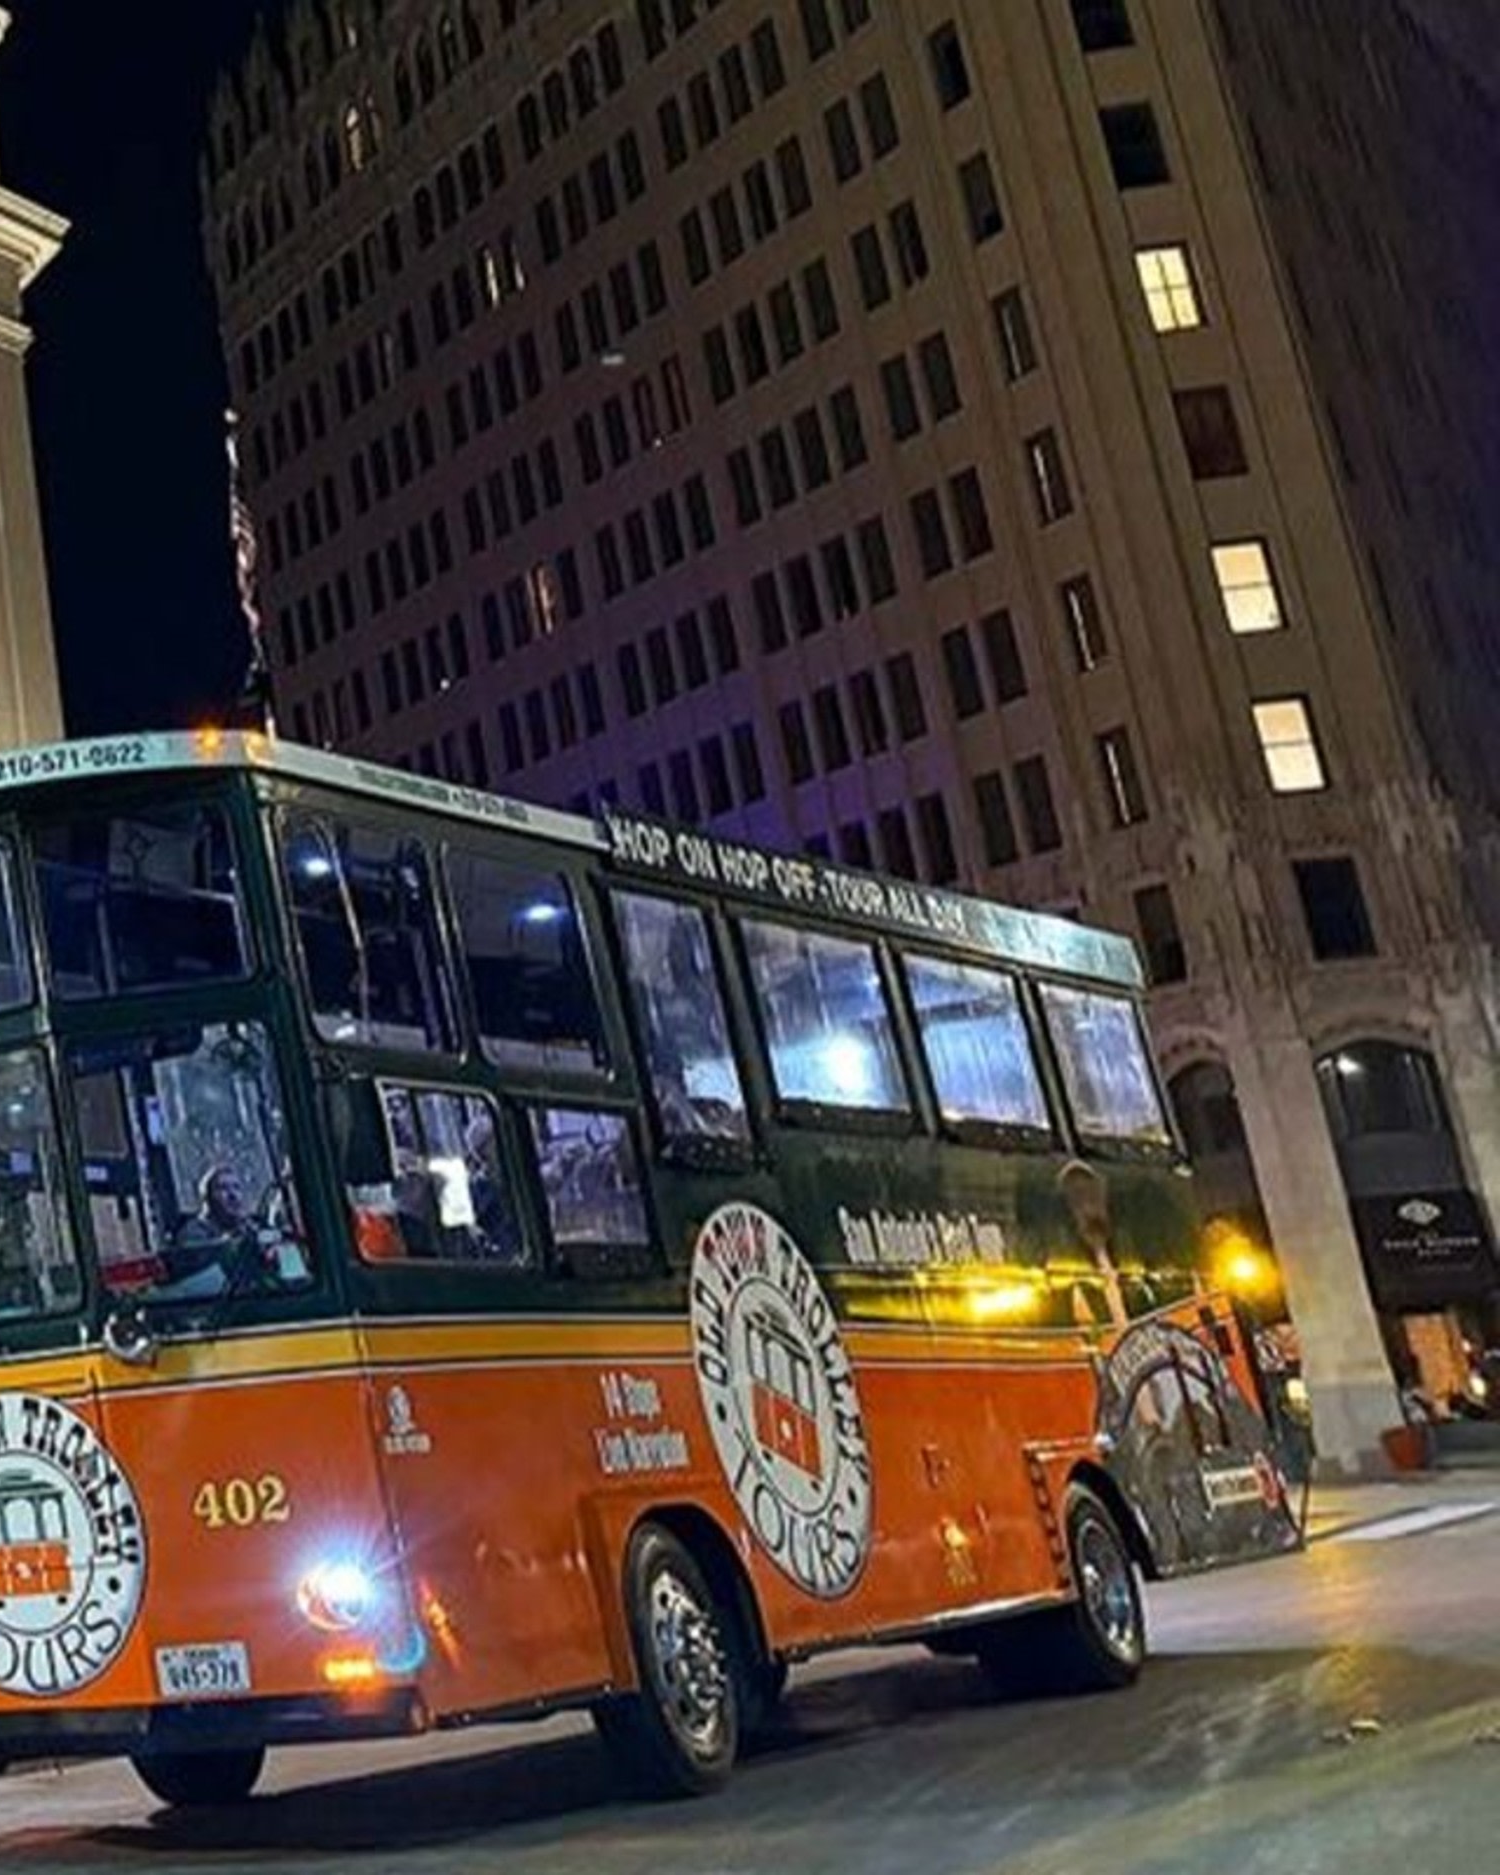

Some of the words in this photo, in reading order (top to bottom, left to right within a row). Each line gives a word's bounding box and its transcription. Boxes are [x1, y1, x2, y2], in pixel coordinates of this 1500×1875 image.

[612, 816, 670, 869] HOP
[675, 832, 717, 880] ON
[716, 842, 769, 892] HOP
[771, 855, 818, 902] OFF
[777, 1230, 873, 1487] TROLLEY
[194, 1474, 290, 1528] 402
[733, 1427, 861, 1588] TOURS
